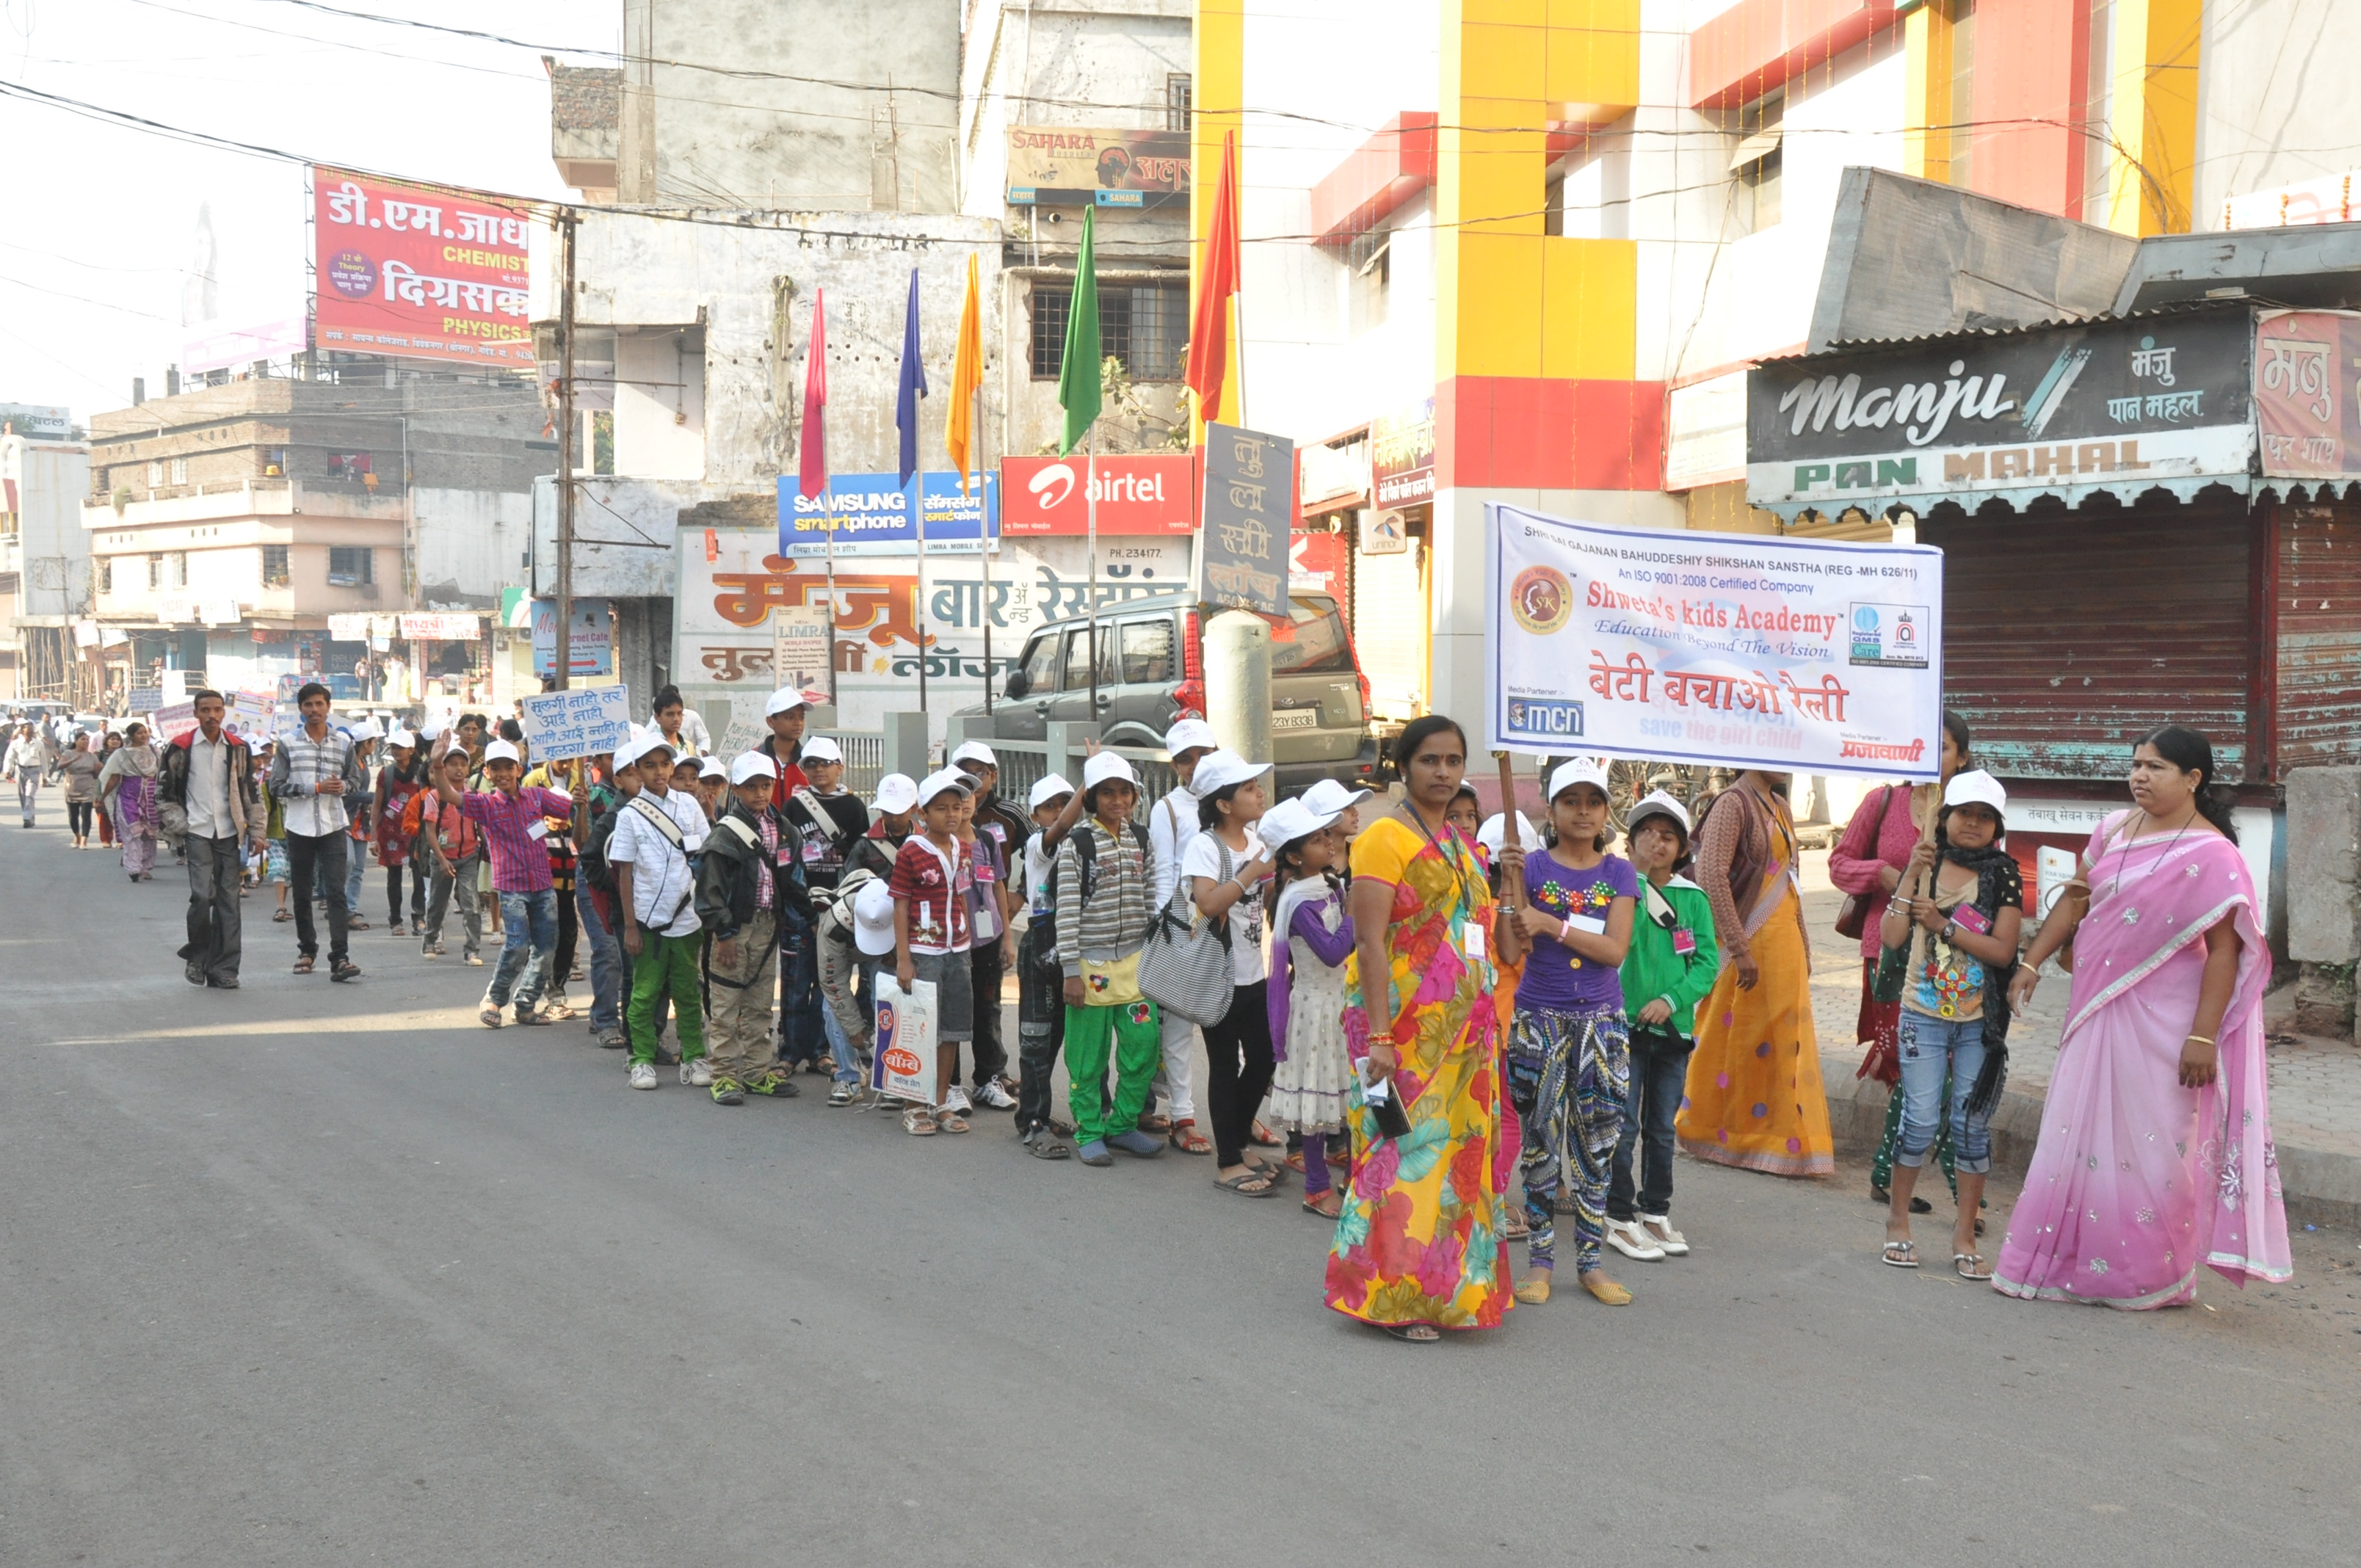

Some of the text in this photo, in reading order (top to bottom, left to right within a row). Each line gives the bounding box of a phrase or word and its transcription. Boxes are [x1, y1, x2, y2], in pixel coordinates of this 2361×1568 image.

[1012, 130, 1095, 153] SAHARA
[1109, 193, 1141, 203] SAHARA
[326, 181, 529, 250] डी.एम.जाध
[338, 261, 365, 273] Theory
[343, 253, 351, 261] 12
[382, 260, 529, 317] दिग्रसक
[443, 316, 522, 340] PHYSICS
[2130, 335, 2176, 387] मंजु
[2262, 318, 2333, 424] मंजु
[1780, 360, 2015, 446] Manju
[2108, 399, 2142, 424] पान
[1794, 439, 2151, 492] PAN MAHAL
[1084, 471, 1165, 501] airtel
[794, 492, 906, 513] SAMSUNG
[951, 542, 973, 551] MOBILE
[1109, 548, 1162, 558] PH. 234177.
[1371, 540, 1397, 550] uninor
[1524, 526, 1918, 581] SHRI SAI GAJANAN BAHUDDESHIY SHIKSHAN SANSTHA (REG -MH 626/11)
[1618, 568, 1814, 596] An ISO 9001:2008 Certified Company
[712, 553, 937, 647] मंजू
[931, 579, 1013, 629] बार
[1261, 601, 1275, 612] AC
[1533, 596, 1557, 611] SK
[1586, 580, 1676, 622] Shweta's
[1681, 598, 1727, 628] kids
[1734, 604, 1838, 642] Academy
[590, 632, 609, 642] Cafe
[778, 625, 830, 639] LIMRA
[1594, 620, 1829, 658] Education Beyond The Vision
[1852, 644, 1879, 657] Care
[1508, 685, 1557, 696] Media Partener
[1589, 649, 1850, 723] बेटी बचाओ रैली
[531, 691, 624, 717] मुलगी नाही तर
[573, 706, 607, 722] नाही
[588, 721, 616, 736] नाही
[1528, 705, 1580, 733] mcn
[1639, 716, 1804, 751] save the girl child
[1840, 731, 1882, 743] Media Partener
[544, 736, 619, 761] मुलगा नाही
[1838, 738, 1926, 762] प्रजावाणी
[2028, 805, 2113, 824] तंबाखू सेवन कर्क
[885, 1051, 919, 1072] बॉम्बे
